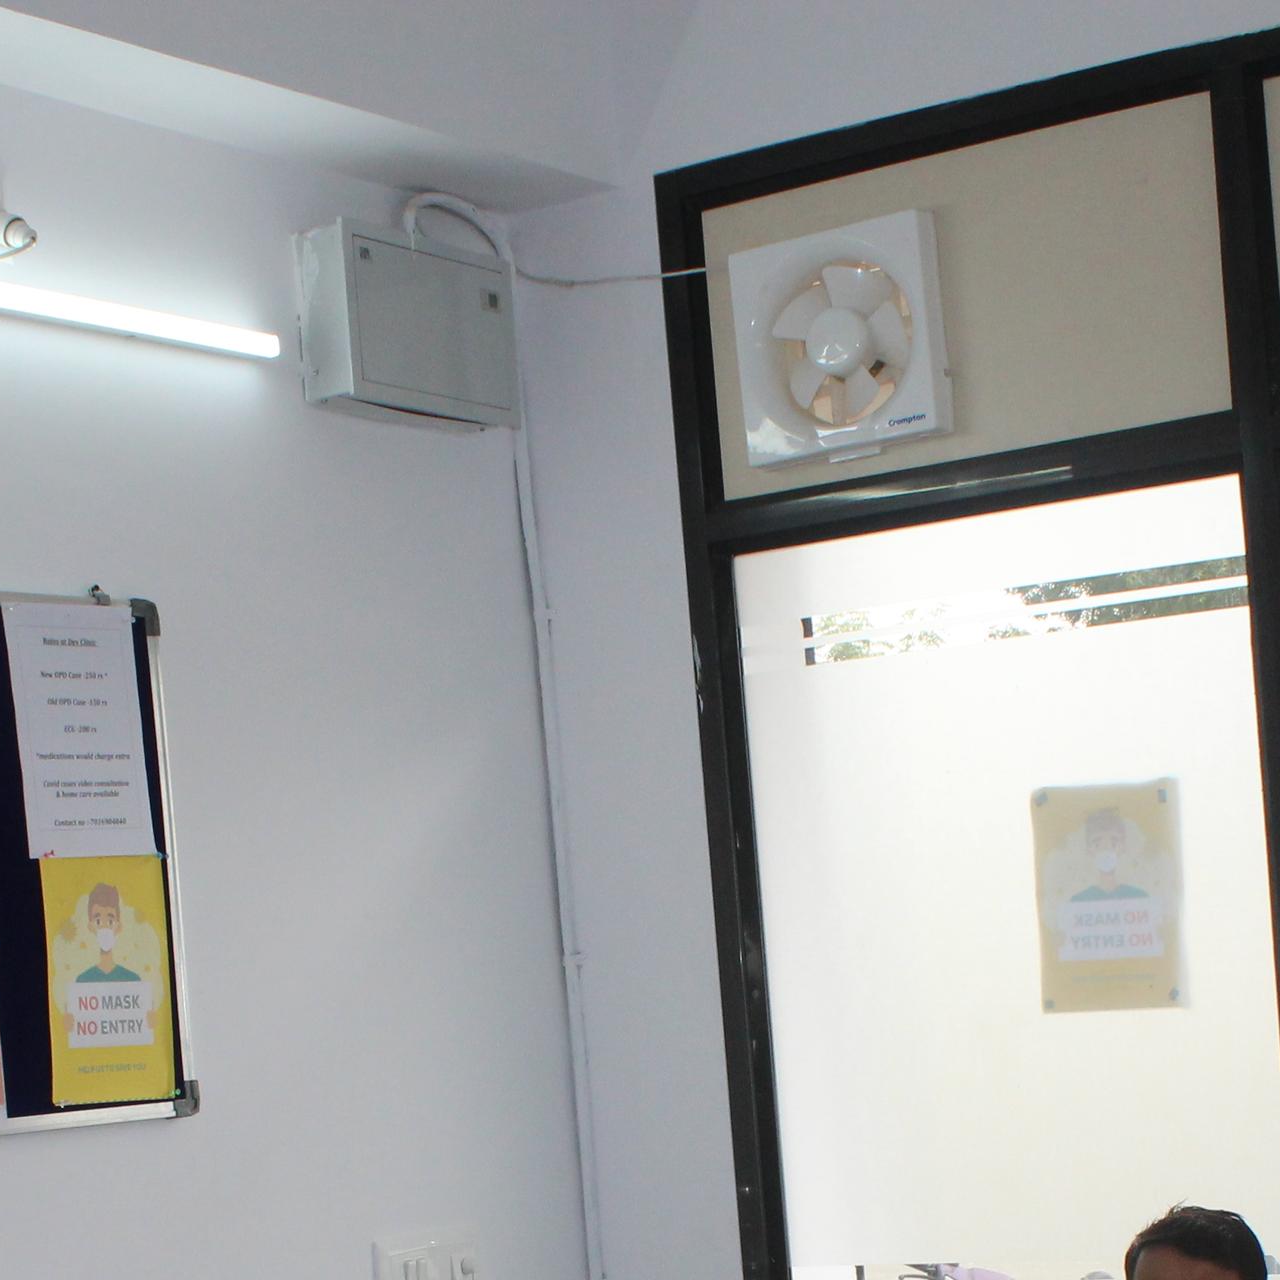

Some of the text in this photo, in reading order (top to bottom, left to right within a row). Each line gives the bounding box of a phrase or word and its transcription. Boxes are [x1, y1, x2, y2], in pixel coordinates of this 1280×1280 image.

[887, 412, 927, 427] Crompton
[78, 994, 141, 1011] NO MASK
[76, 1019, 144, 1036] NO ENTRY
